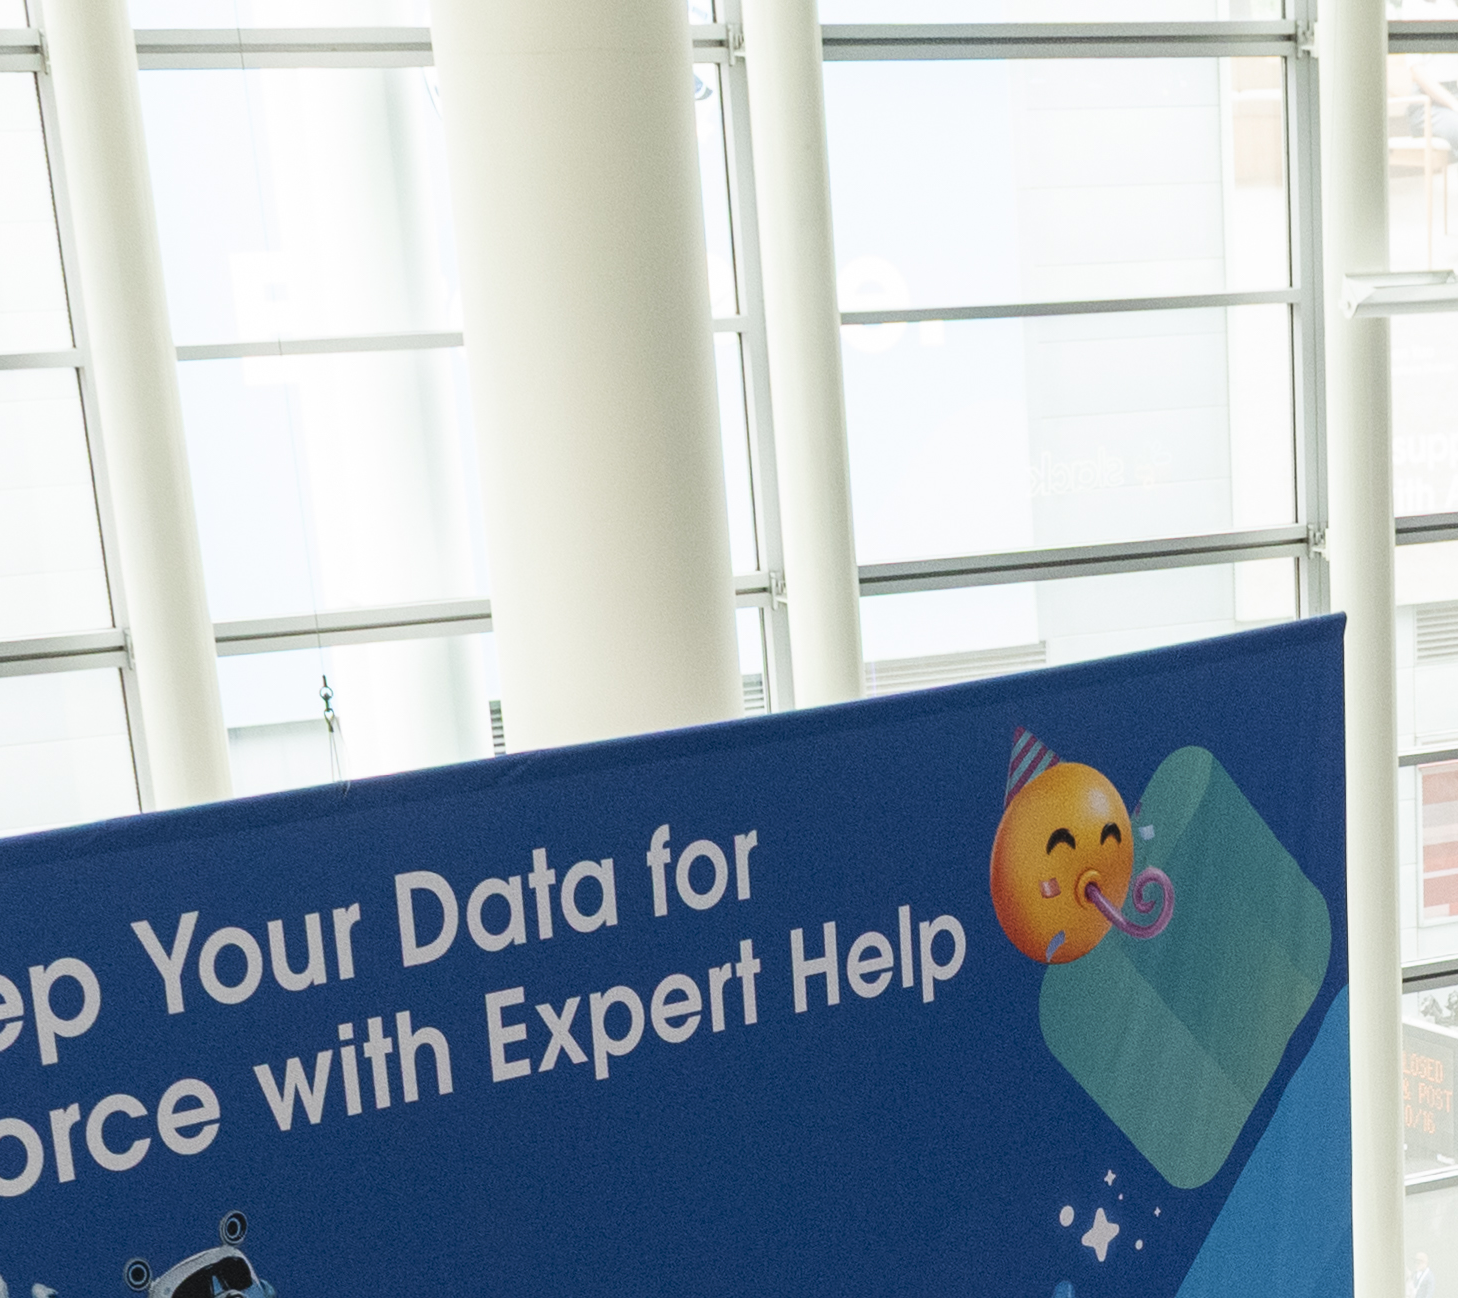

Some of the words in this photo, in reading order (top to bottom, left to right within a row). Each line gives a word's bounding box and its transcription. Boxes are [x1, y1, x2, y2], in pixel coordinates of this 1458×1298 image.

[1395, 477, 1435, 513] ith
[130, 899, 364, 1018] Your
[393, 848, 622, 969] Data
[645, 823, 760, 919] for
[254, 1008, 455, 1133] with
[485, 938, 761, 1081] Expert
[788, 904, 968, 1013] Help
